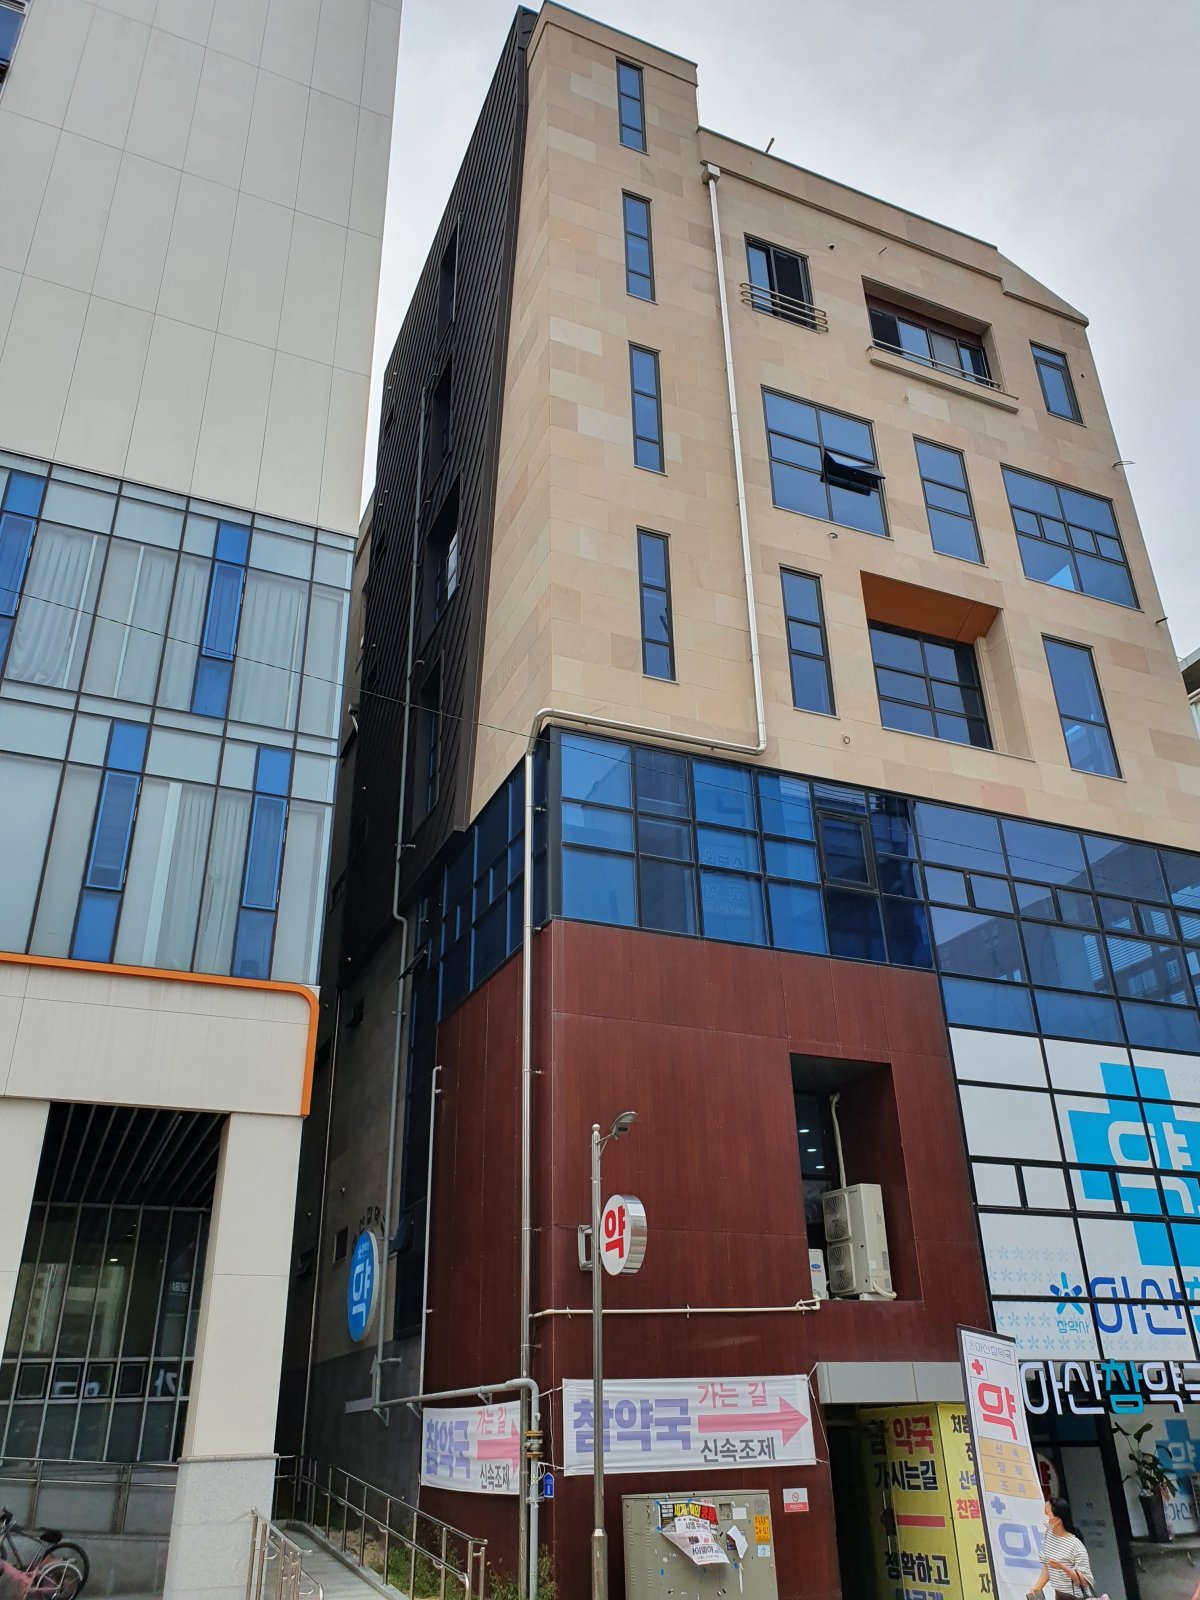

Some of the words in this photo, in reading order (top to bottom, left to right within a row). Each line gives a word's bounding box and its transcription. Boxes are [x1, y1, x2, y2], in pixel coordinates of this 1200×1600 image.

[1107, 1121, 1195, 1214] 약
[605, 1205, 626, 1259] 약
[352, 1259, 372, 1328] 약
[697, 1382, 740, 1408] 가는
[748, 1381, 768, 1407] 길
[978, 1382, 1018, 1441] 약
[477, 1408, 494, 1435] 가는
[497, 1406, 507, 1434] 길
[573, 1398, 692, 1453] 참약국
[425, 1419, 471, 1479] 참약국
[700, 1436, 776, 1463] 신속조제
[480, 1463, 511, 1491] 신속조제
[874, 1460, 939, 1491] 가시는길
[956, 1498, 980, 1519] 친절
